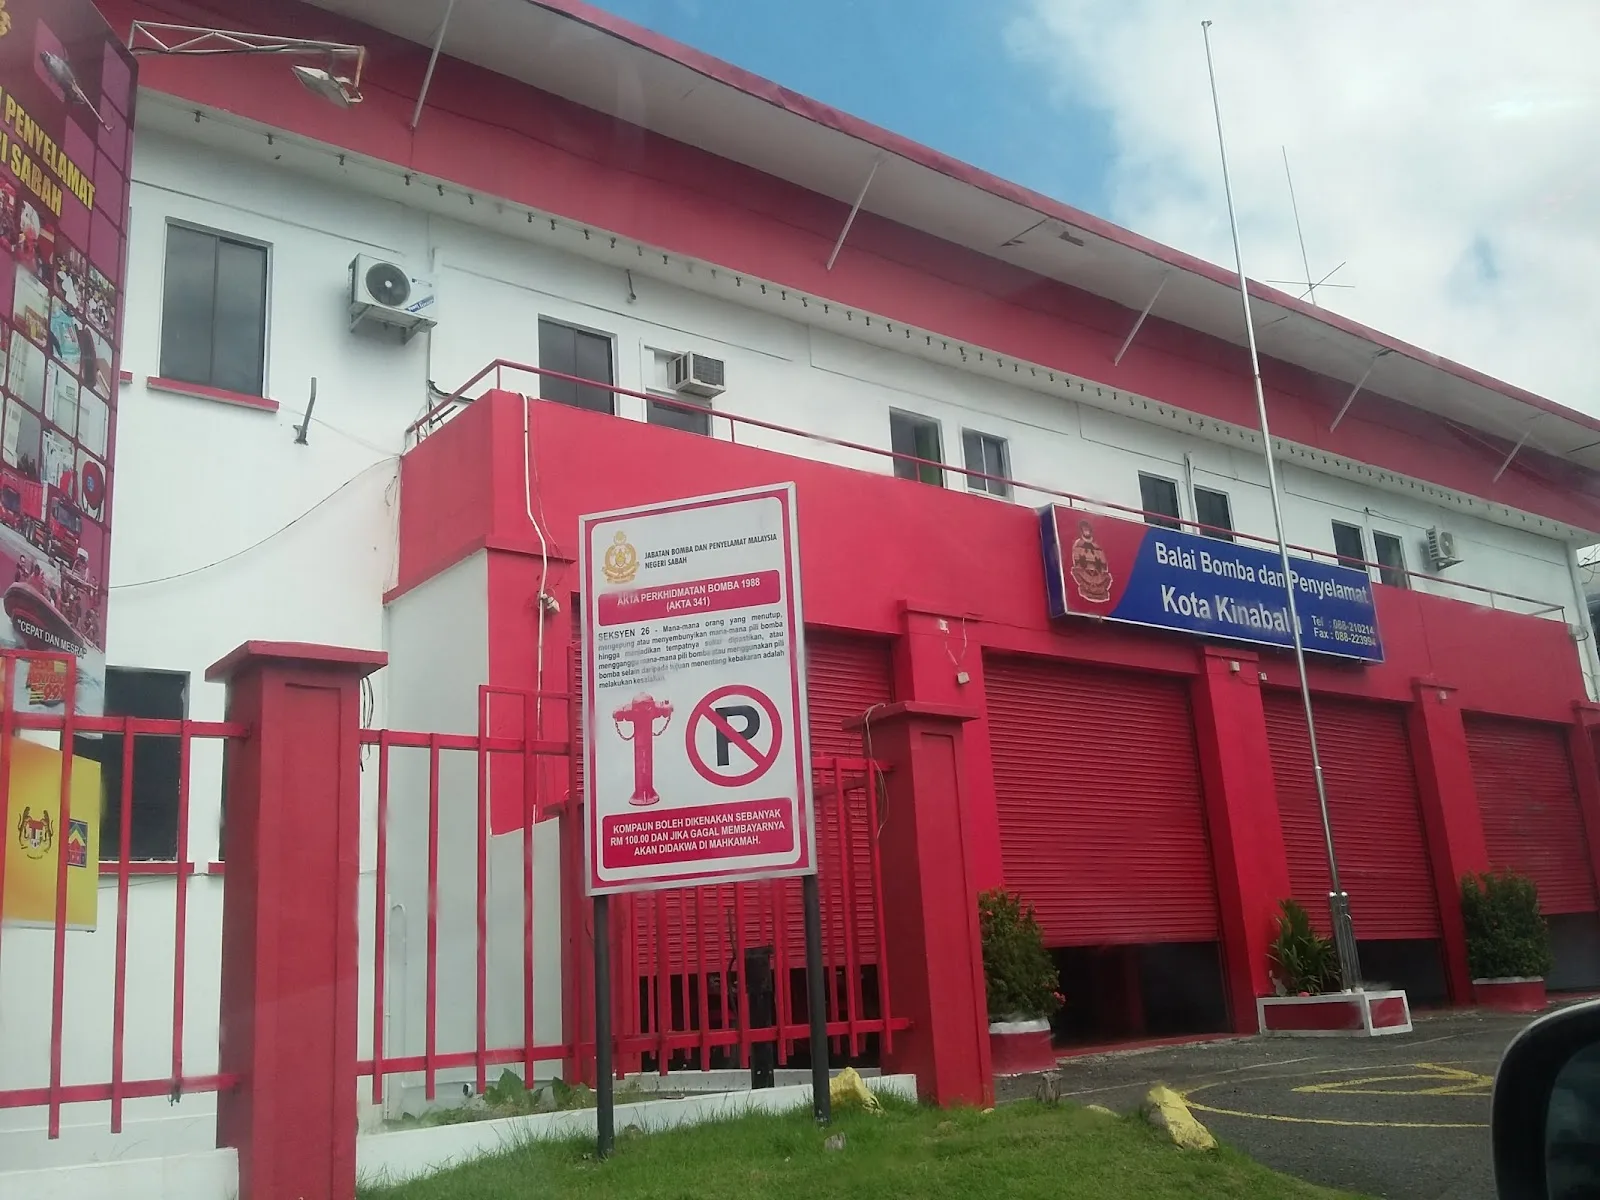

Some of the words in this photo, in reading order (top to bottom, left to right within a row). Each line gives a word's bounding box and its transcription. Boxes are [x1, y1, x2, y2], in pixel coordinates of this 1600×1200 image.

[5, 94, 95, 210] PENYELAMAT
[11, 143, 62, 217] SABAH
[644, 549, 669, 559] JABATAN
[671, 546, 693, 556] BOMBA
[709, 538, 746, 550] PENYELAMAT
[748, 534, 777, 544] MALAYSIA
[645, 560, 666, 569] NEGERI
[668, 557, 687, 566] SABAH
[1155, 542, 1197, 571] Balai
[1200, 551, 1255, 582] Bomba
[1258, 564, 1286, 588] dan
[1289, 570, 1369, 603] Penyelamat
[617, 592, 639, 606] AKTA
[641, 585, 706, 602] PERKHIDMATAN
[708, 581, 739, 592] BOMBA
[741, 578, 760, 588] 1988
[1161, 584, 1211, 619] Kota
[666, 599, 691, 612] (AKTA
[693, 596, 710, 606] 341)
[598, 629, 635, 640] SEKSYEN
[641, 627, 650, 636] 26
[663, 622, 700, 632] Mana-mana
[705, 619, 724, 627] orang
[730, 616, 746, 625] yang
[652, 631, 708, 644] menyembunyikan
[761, 621, 783, 629] bomba
[1312, 615, 1324, 626] Tel
[1333, 619, 1375, 634] 088-210214
[1314, 628, 1329, 639] Fax
[45, 632, 60, 647] DAN
[599, 652, 620, 661] hingga
[666, 642, 699, 651] tempatnya
[728, 653, 761, 663] kebakaran
[763, 650, 784, 658] adalah
[599, 678, 632, 688] melakukan
[613, 822, 653, 834] KOMPAUN
[655, 819, 683, 829] BOLEH
[686, 814, 734, 827] DIKENAKAN
[735, 809, 781, 822] SEBANYAK
[611, 837, 623, 846] RM
[625, 834, 649, 845] 100.00
[651, 832, 668, 842] DAN
[670, 830, 688, 840] JIKA
[690, 827, 719, 838] GAGAL
[721, 821, 785, 835] MEMBAYARNYA
[634, 845, 657, 856] AKAN
[659, 842, 697, 853] DIDAKWA
[699, 840, 708, 850] DI
[709, 836, 760, 849] MAHKAMAH.
